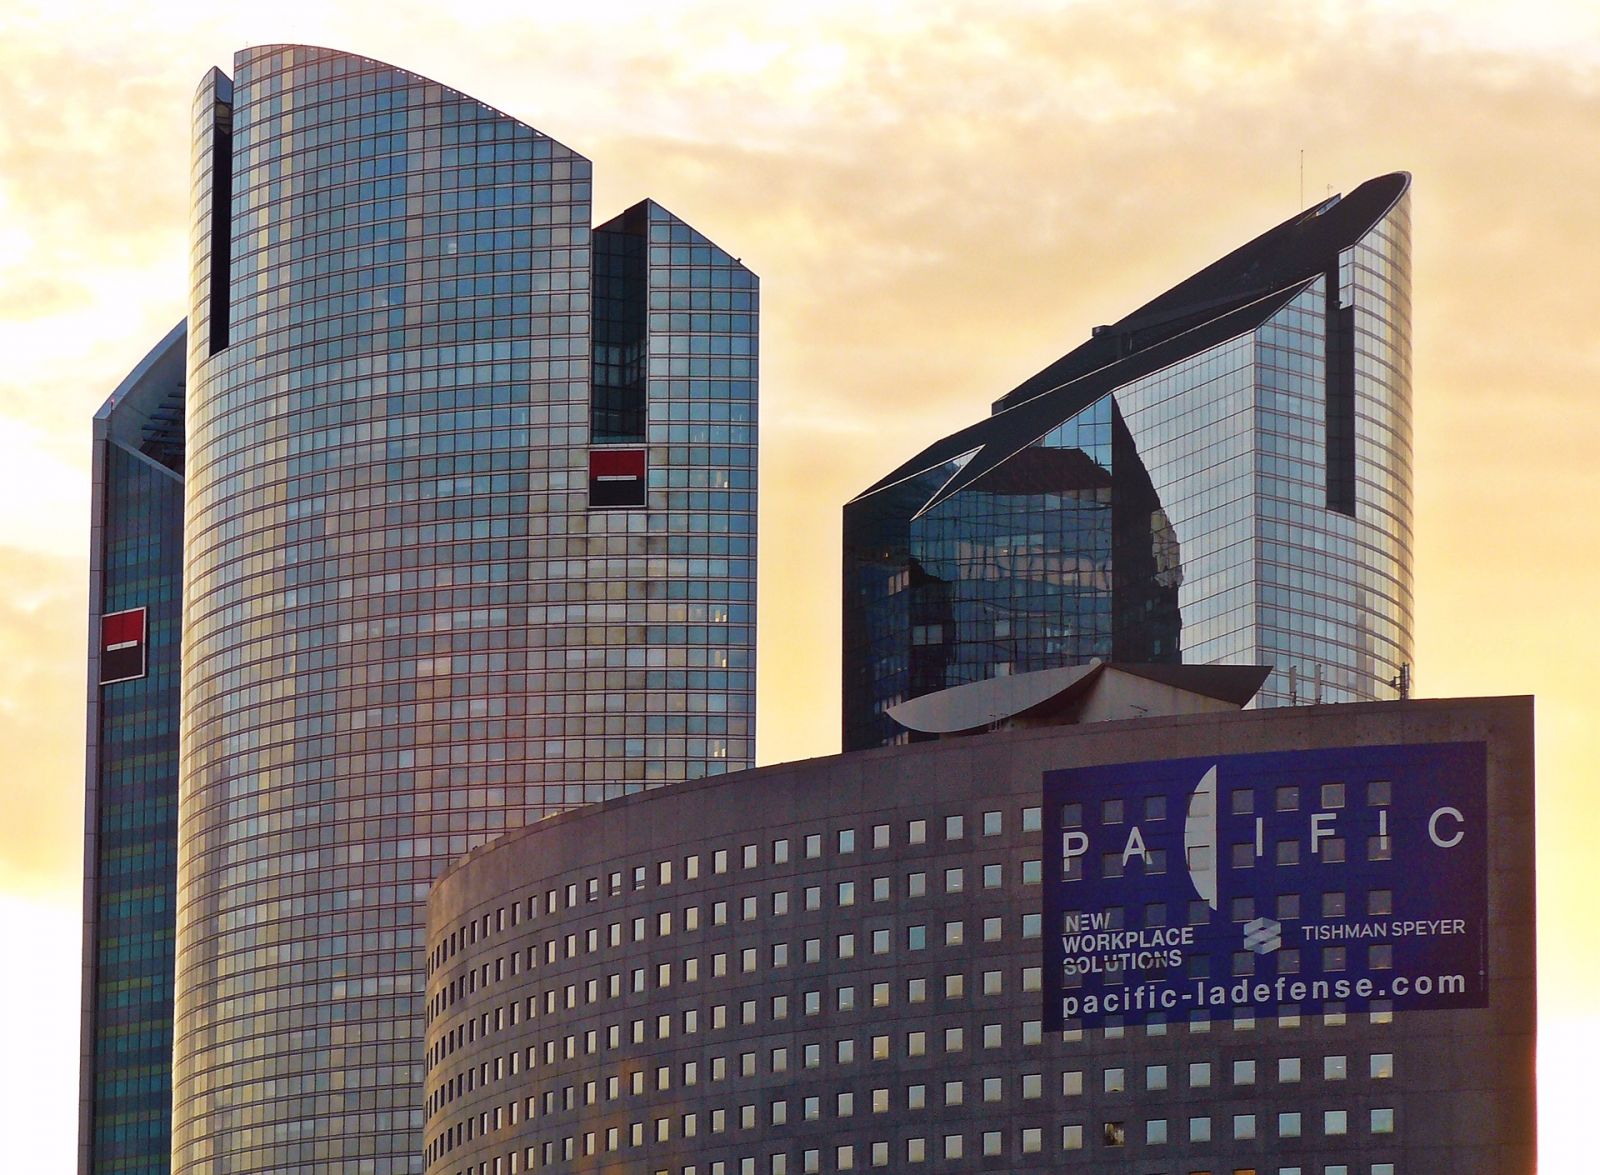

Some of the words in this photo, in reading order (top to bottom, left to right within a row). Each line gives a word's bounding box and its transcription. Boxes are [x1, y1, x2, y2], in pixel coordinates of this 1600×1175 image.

[1065, 912, 1111, 933] NEW
[1301, 922, 1387, 941] TISHMAN
[1391, 919, 1466, 937] SPEYER
[1062, 927, 1194, 954] WORKPLACE
[1063, 949, 1182, 975] SOLUTIONS
[1062, 974, 1466, 1019] pacific-ladefense.com
